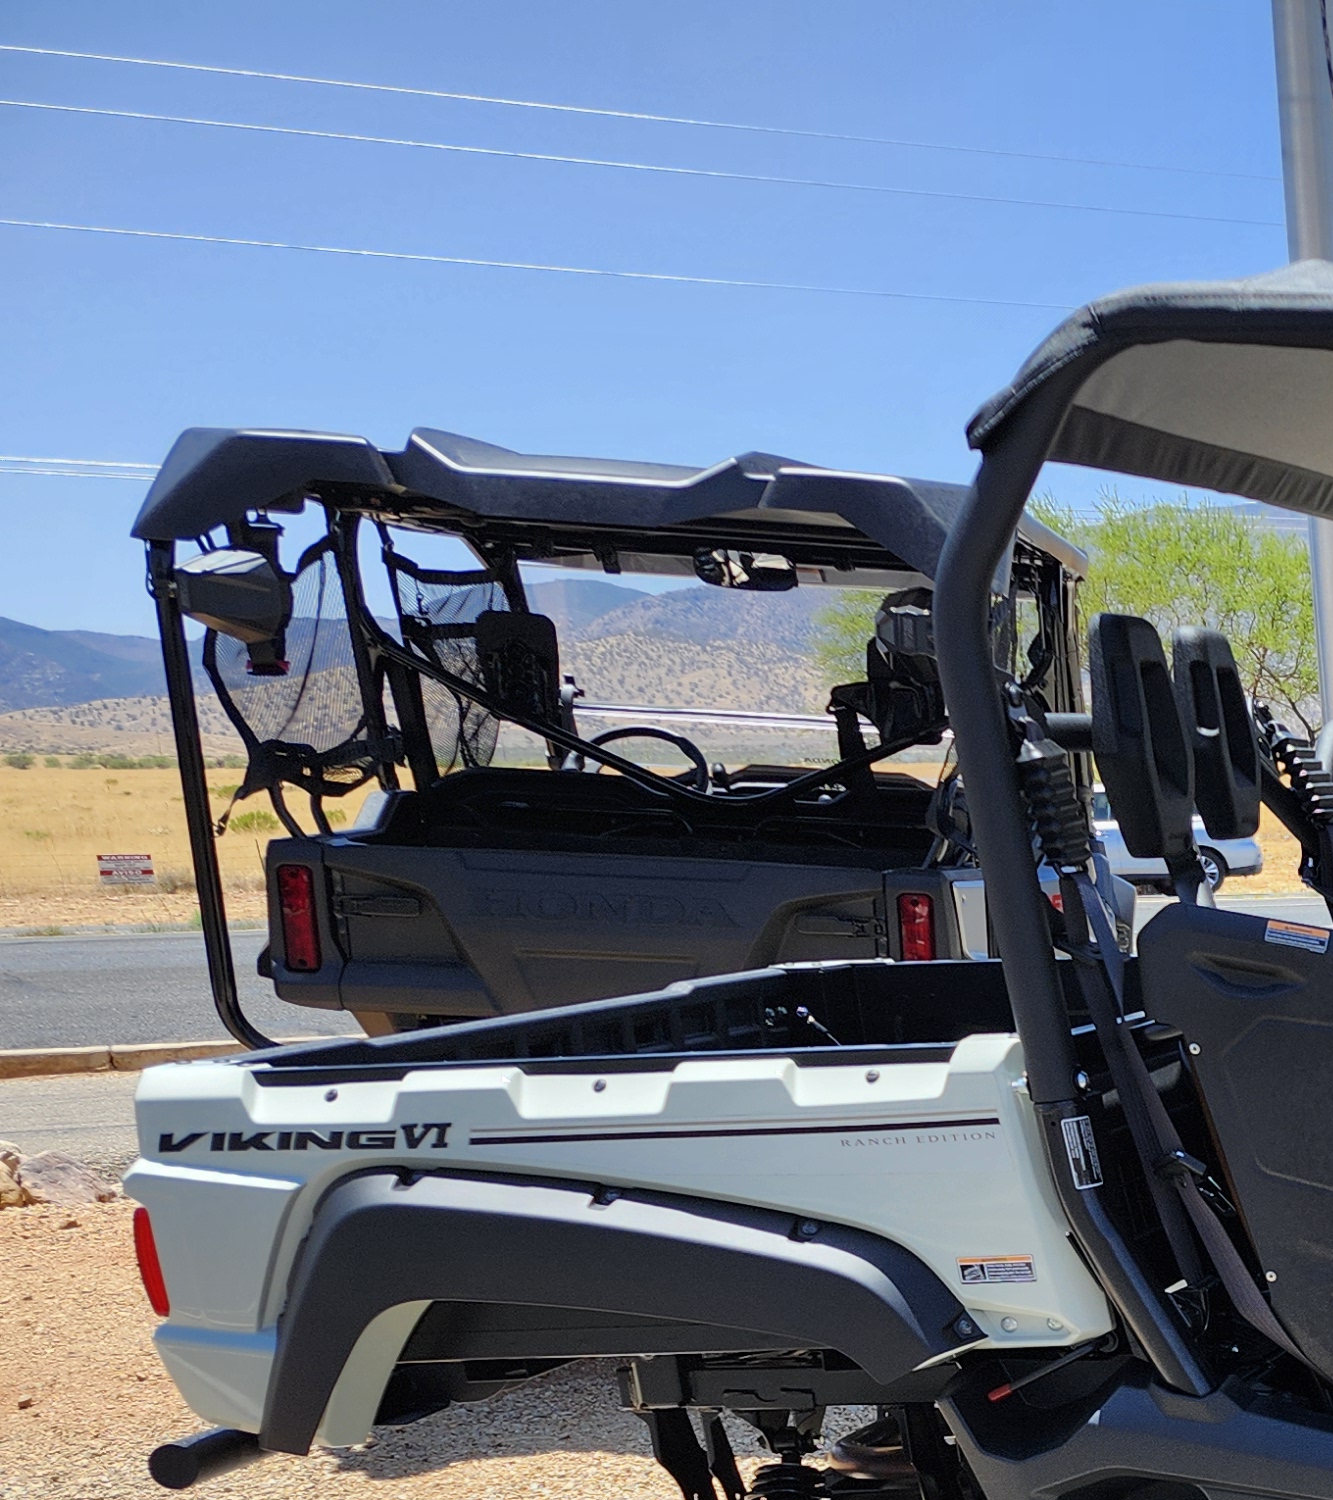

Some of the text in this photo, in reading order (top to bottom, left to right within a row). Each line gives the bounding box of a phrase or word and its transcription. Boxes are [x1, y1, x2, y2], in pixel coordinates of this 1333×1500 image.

[468, 888, 745, 928] HONDA
[840, 1131, 997, 1147] RANCH EDITION
